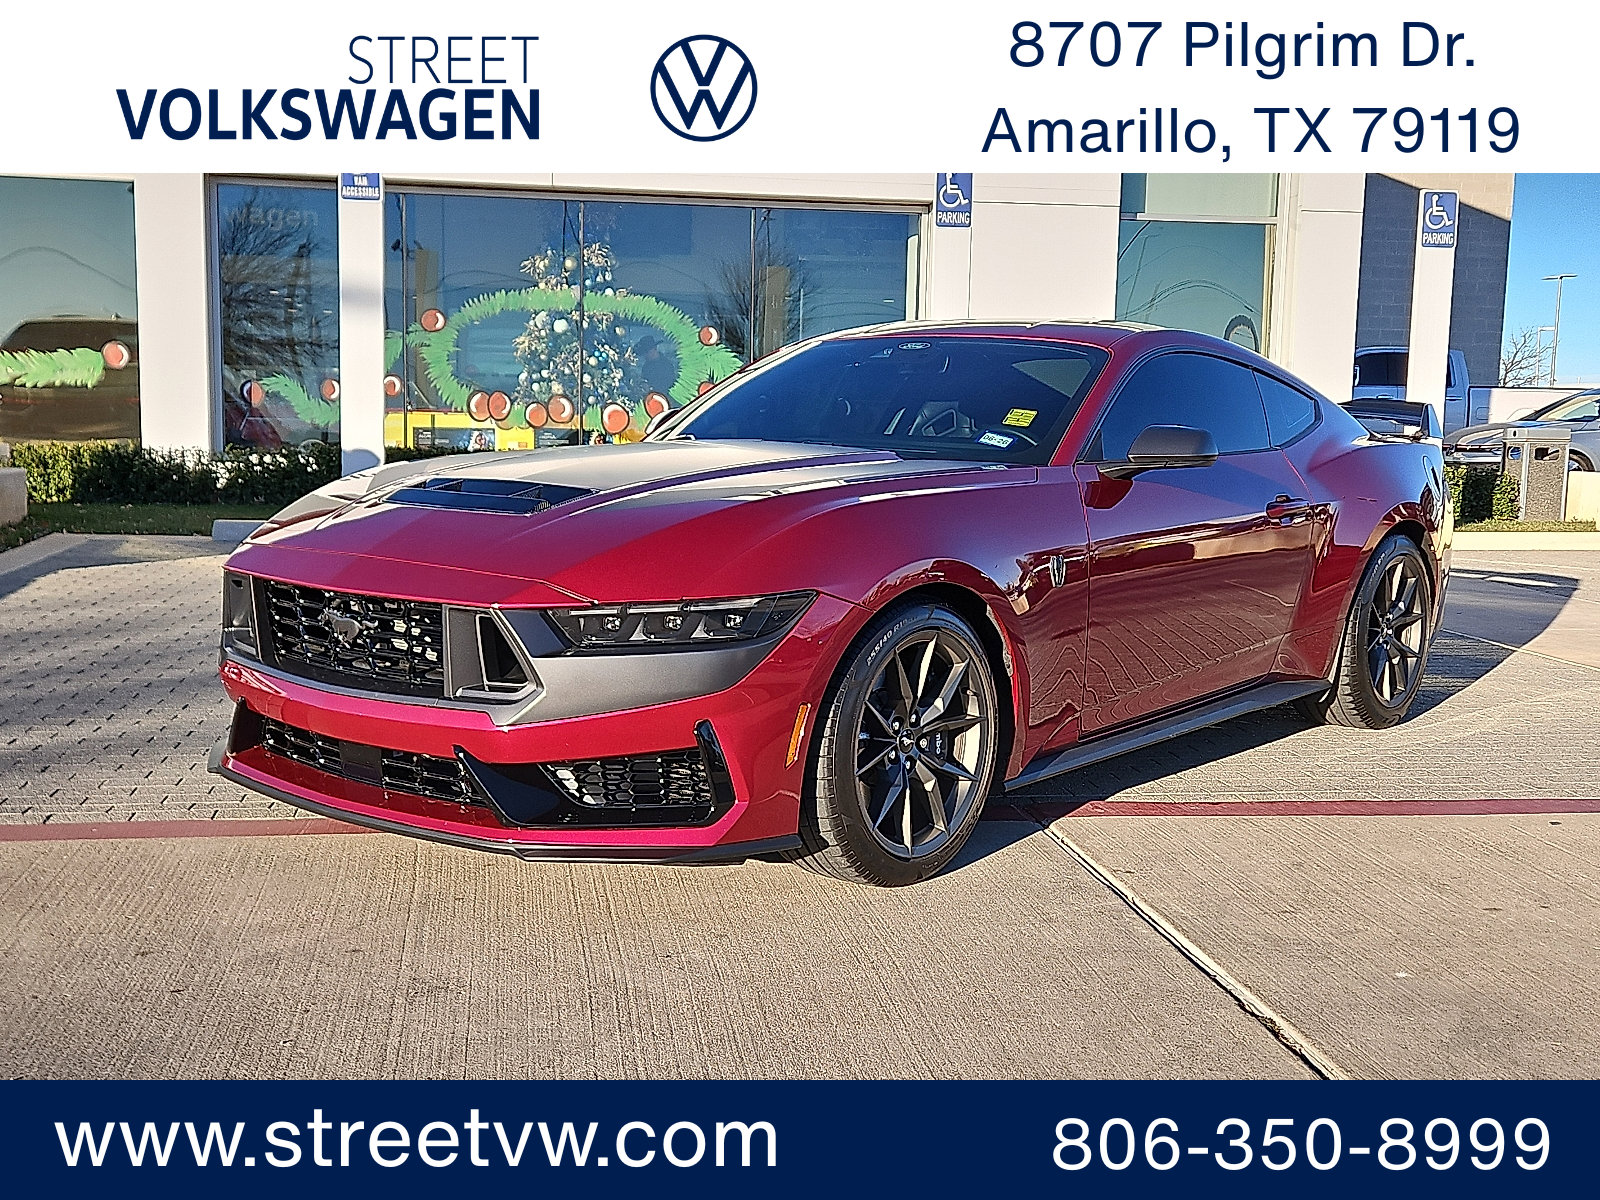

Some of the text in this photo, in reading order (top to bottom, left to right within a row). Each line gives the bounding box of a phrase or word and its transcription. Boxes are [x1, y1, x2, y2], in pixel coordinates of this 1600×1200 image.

[342, 186, 379, 197] ACCESSIBLE
[937, 211, 970, 224] PARKING
[1422, 232, 1454, 245] PARKING
